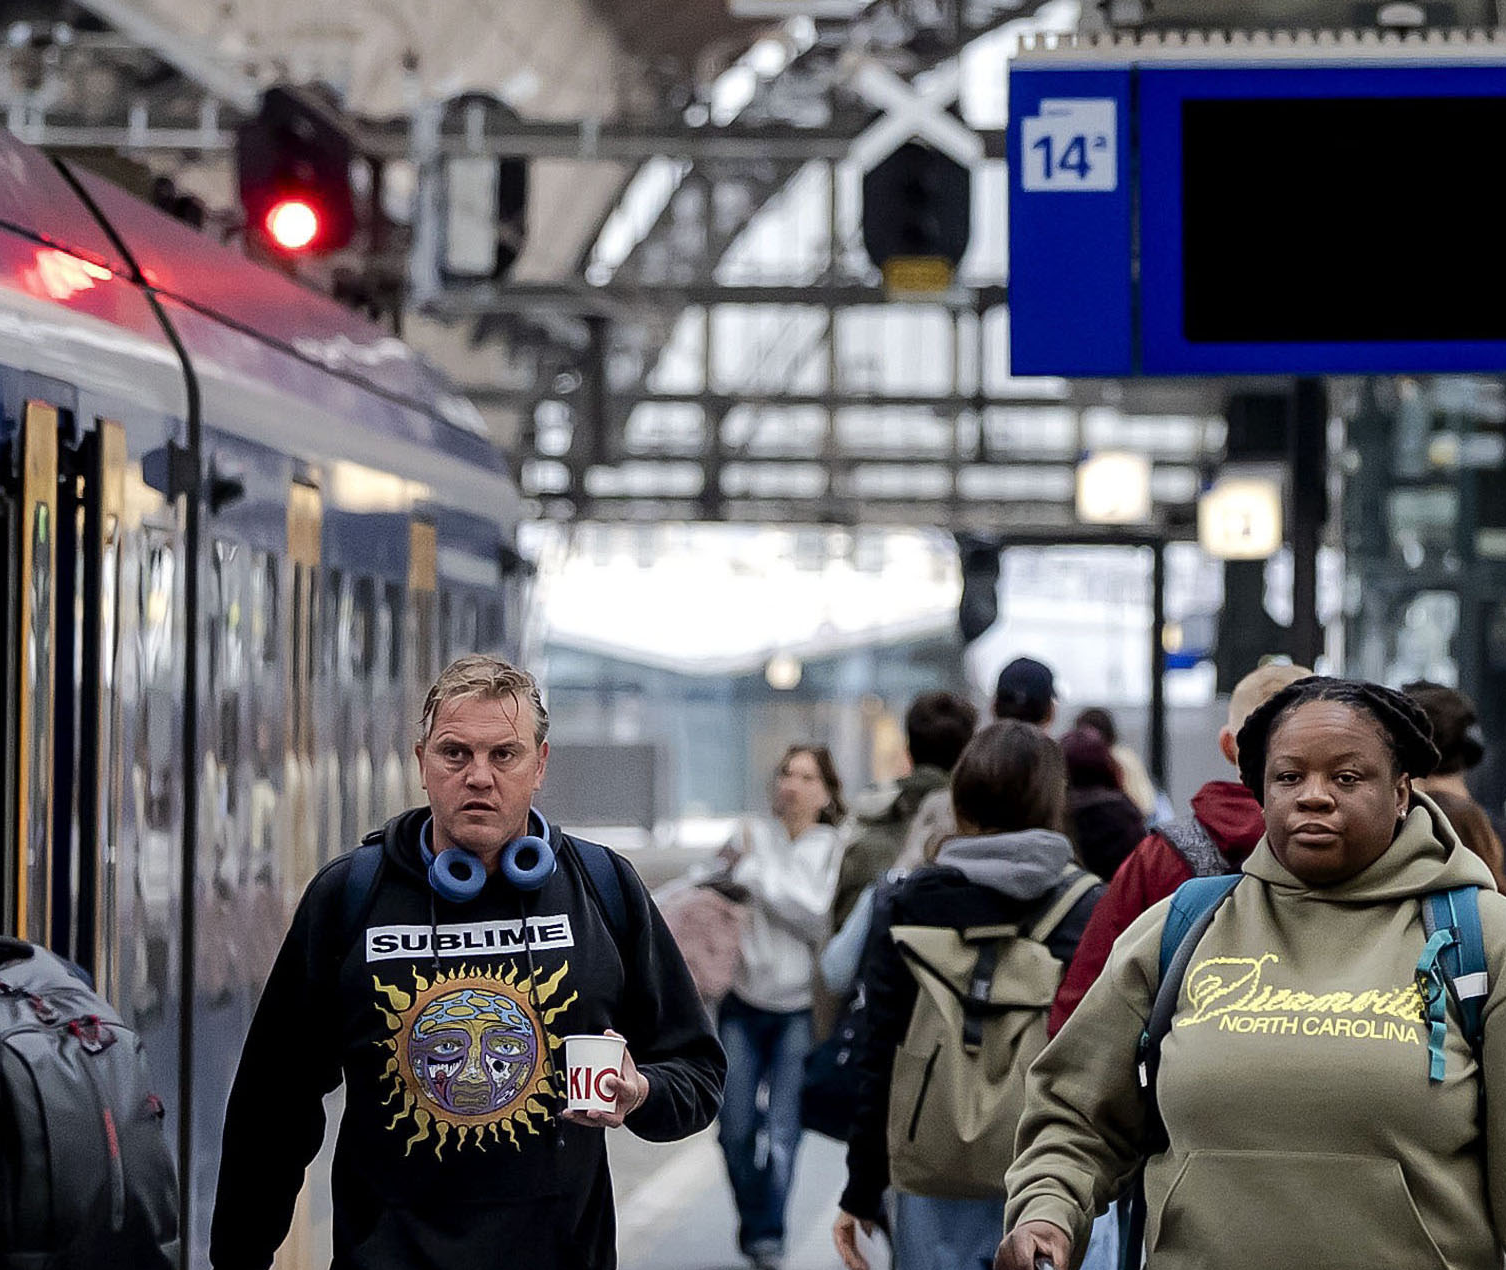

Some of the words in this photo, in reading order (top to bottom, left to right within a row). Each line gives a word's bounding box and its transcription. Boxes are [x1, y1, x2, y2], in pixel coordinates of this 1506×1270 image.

[371, 922, 569, 954] SUBLIME
[1219, 1014, 1299, 1035] NORTH
[1302, 1016, 1420, 1045] CAROLINA
